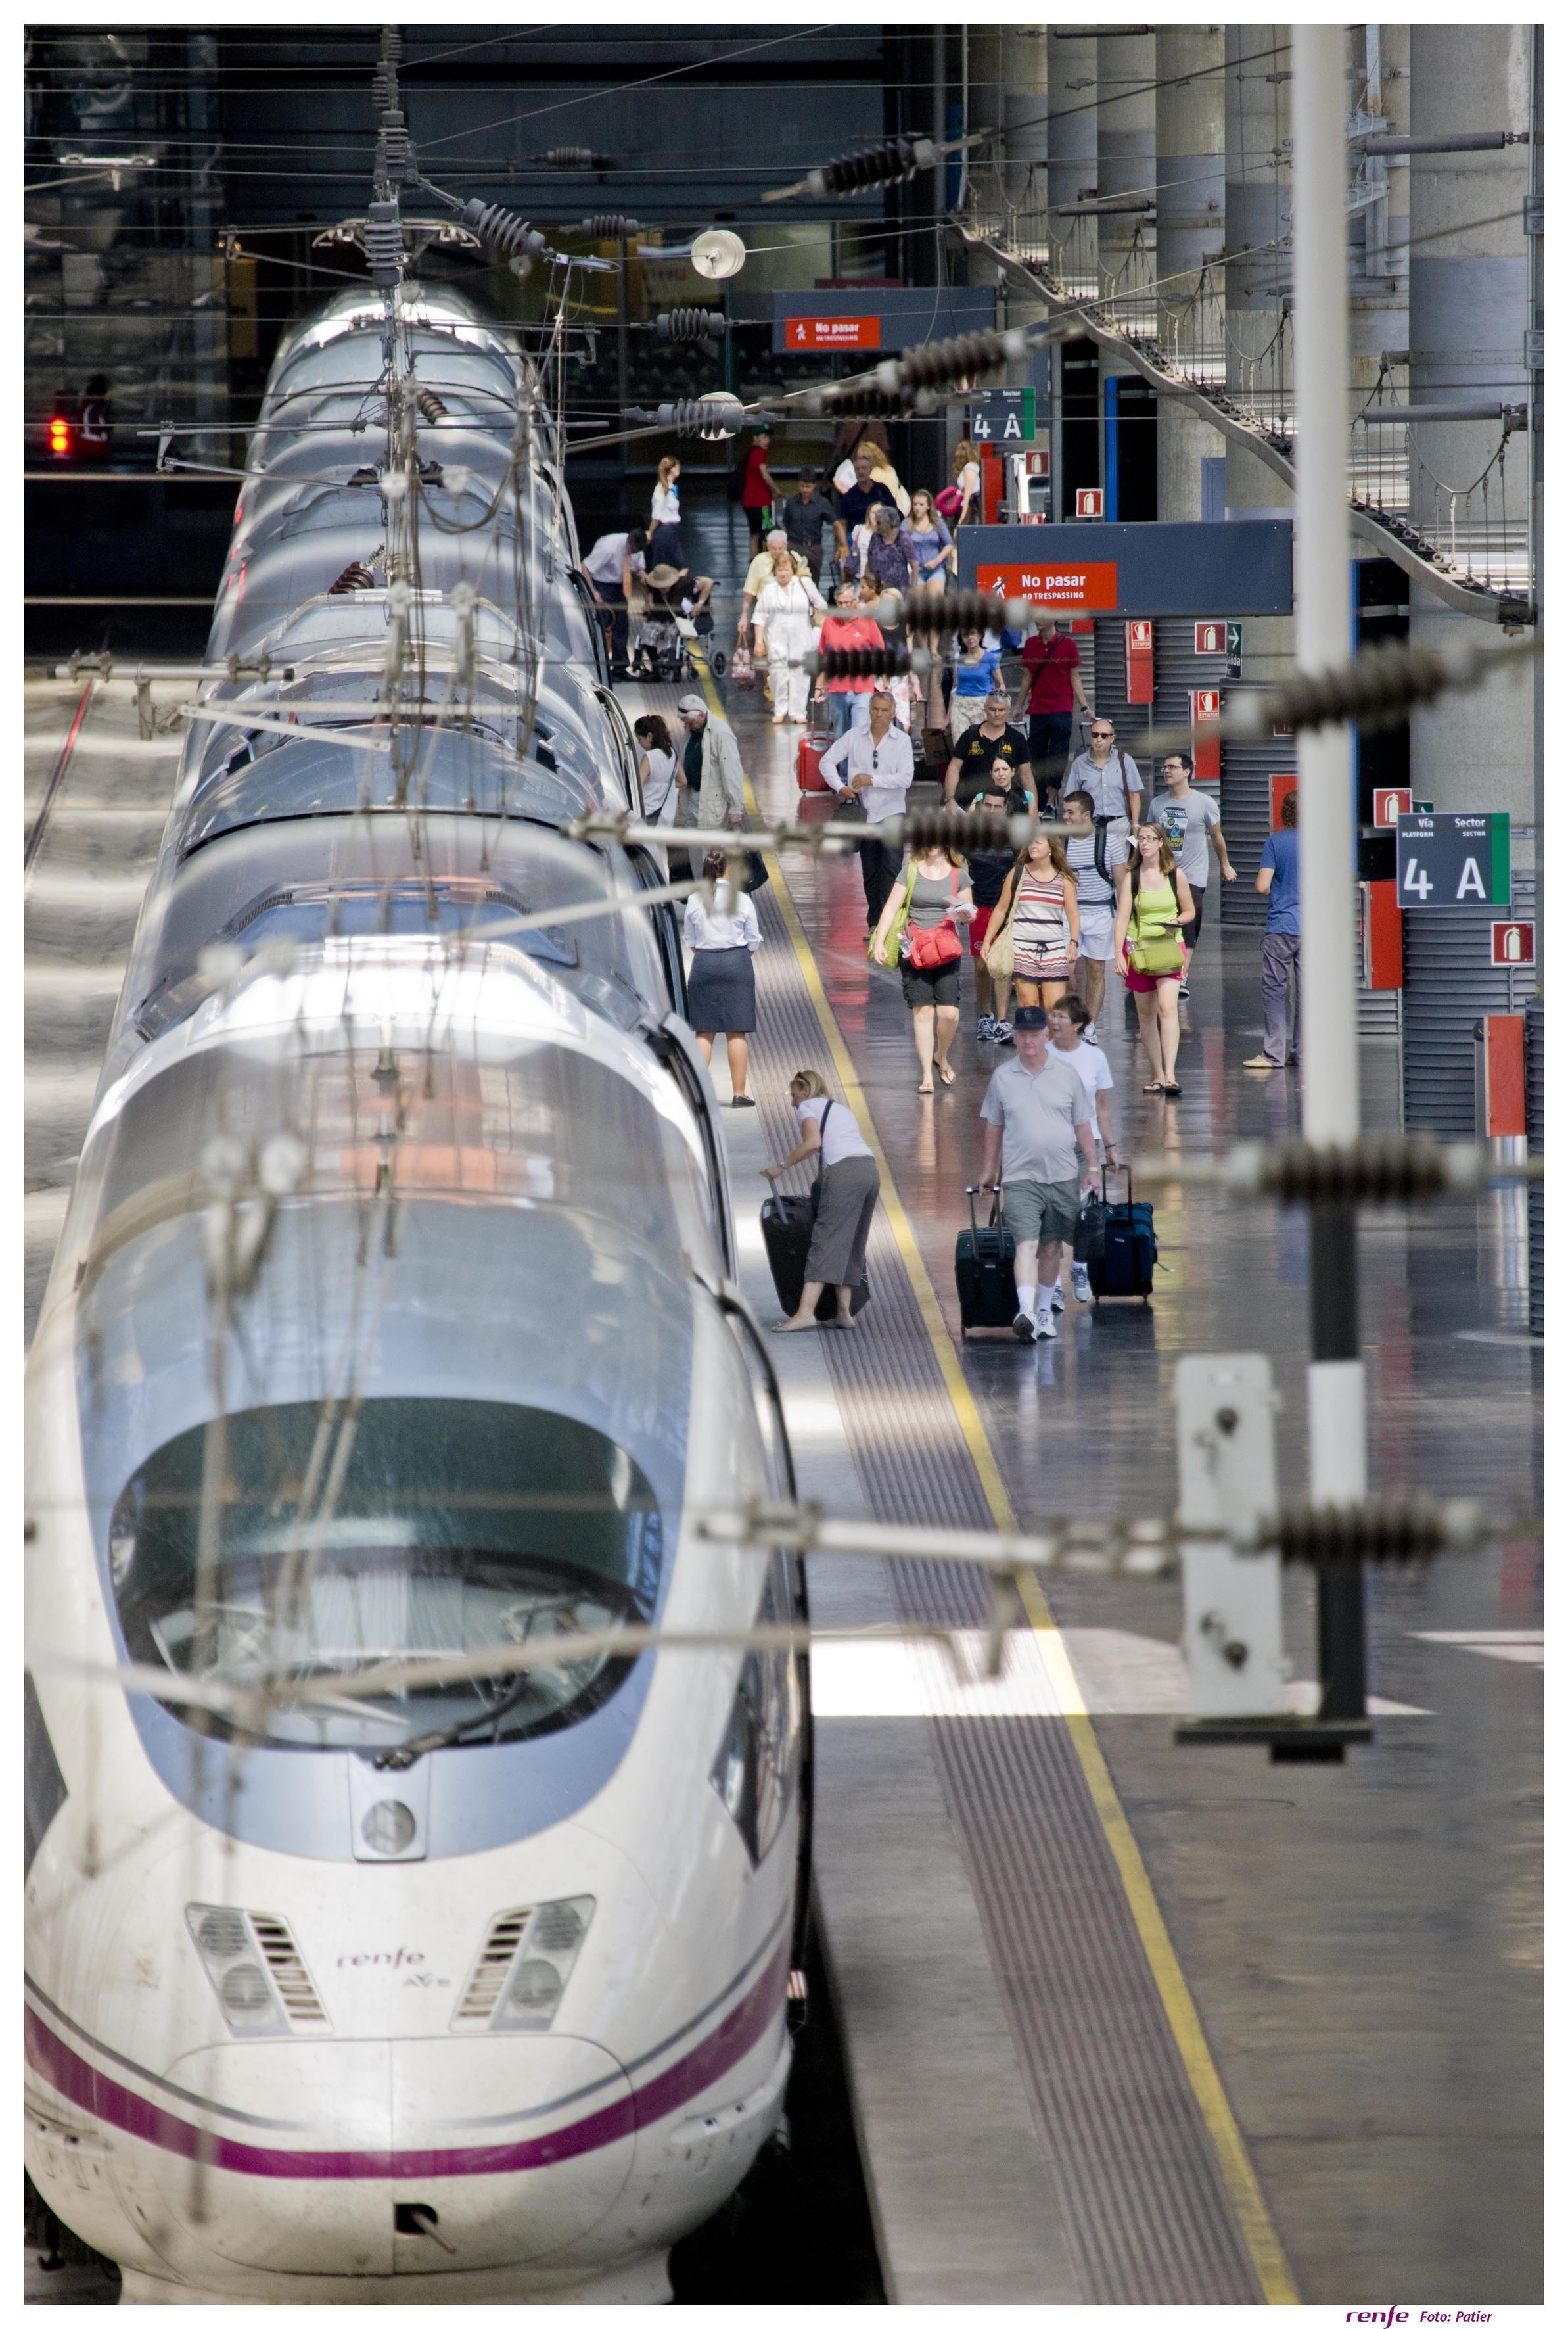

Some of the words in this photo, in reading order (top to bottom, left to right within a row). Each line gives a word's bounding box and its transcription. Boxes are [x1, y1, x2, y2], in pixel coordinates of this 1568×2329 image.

[815, 322, 829, 333] No
[832, 323, 860, 334] pasar
[974, 413, 991, 438] 4
[1003, 413, 1021, 438] A
[1022, 575, 1041, 587] No
[1046, 576, 1086, 590] pasar
[1418, 818, 1434, 828] Vía
[1455, 818, 1486, 828] Sector
[1404, 859, 1434, 899] 4
[1456, 857, 1487, 899] A
[336, 1946, 425, 1970] renfe
